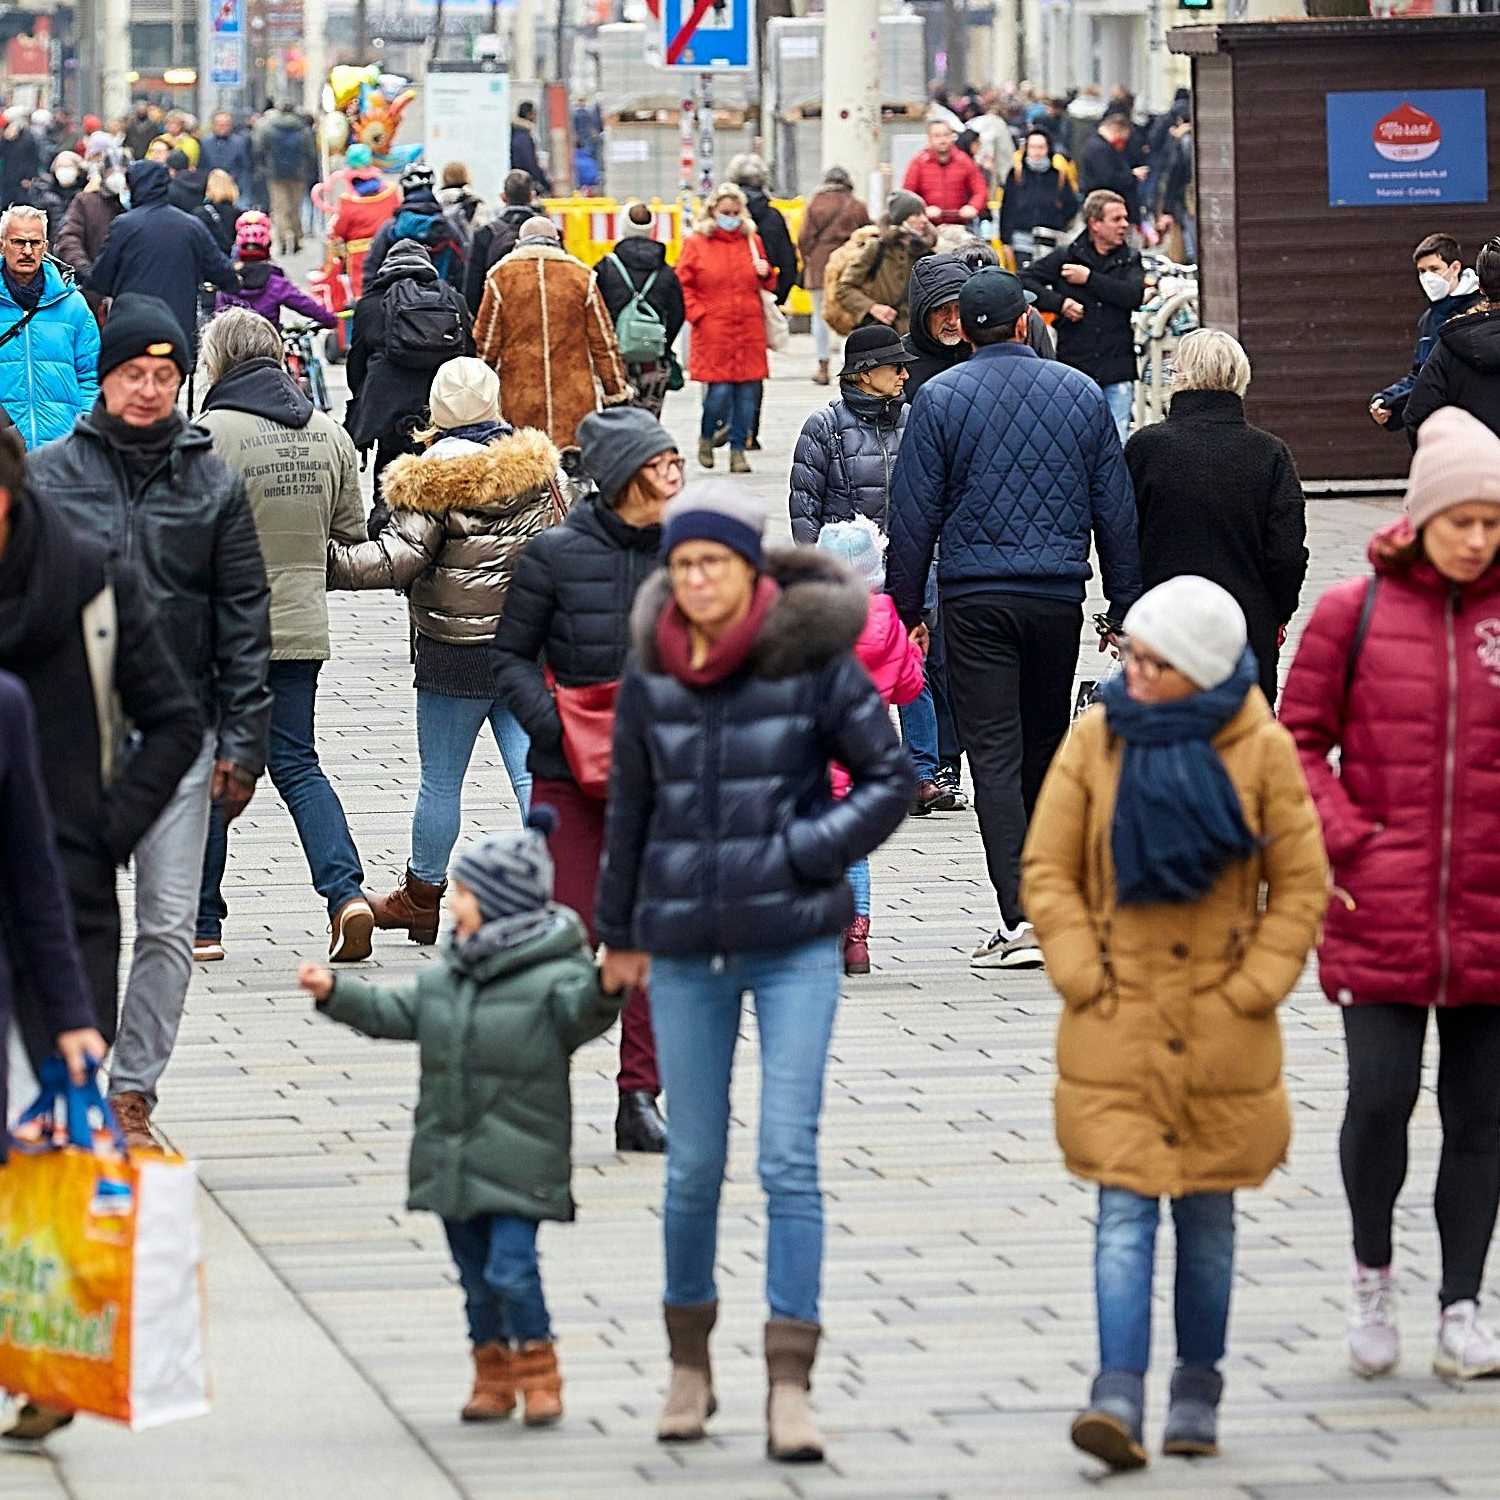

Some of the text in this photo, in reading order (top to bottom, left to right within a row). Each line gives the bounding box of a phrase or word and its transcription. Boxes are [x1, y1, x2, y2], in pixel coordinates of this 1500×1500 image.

[240, 433, 280, 451] AVIATOR
[244, 461, 294, 478] REGISTERED
[299, 472, 316, 482] 1975
[264, 485, 291, 498] ORDER
